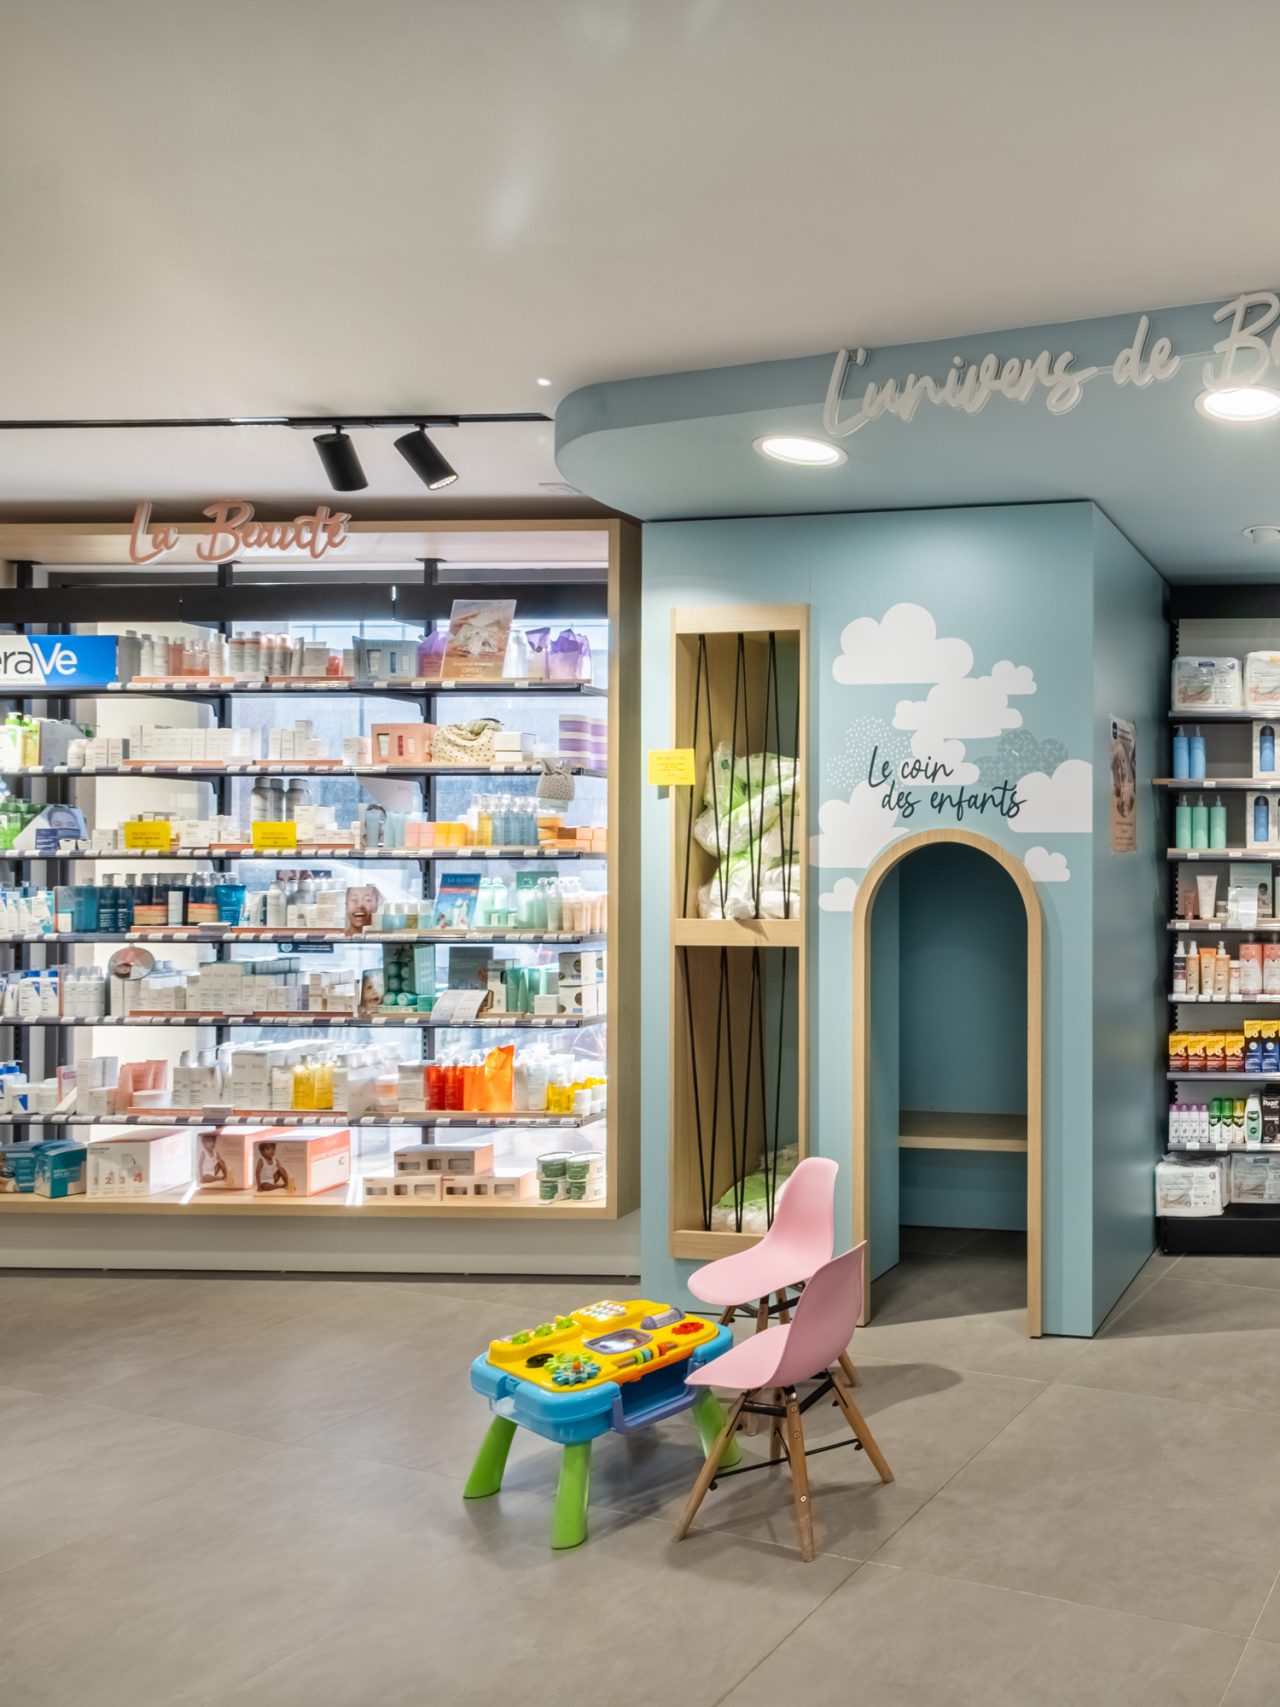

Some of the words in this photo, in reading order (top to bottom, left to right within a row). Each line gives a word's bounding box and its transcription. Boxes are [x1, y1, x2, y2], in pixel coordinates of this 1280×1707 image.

[822, 347, 1098, 437] L'univers
[1111, 314, 1181, 388] de
[130, 500, 179, 565] La
[196, 499, 352, 565] Beauté
[0, 643, 78, 675] raVe
[868, 745, 892, 788] Le
[901, 756, 954, 783] coin
[881, 780, 922, 819] des
[930, 780, 1028, 821] enfants
